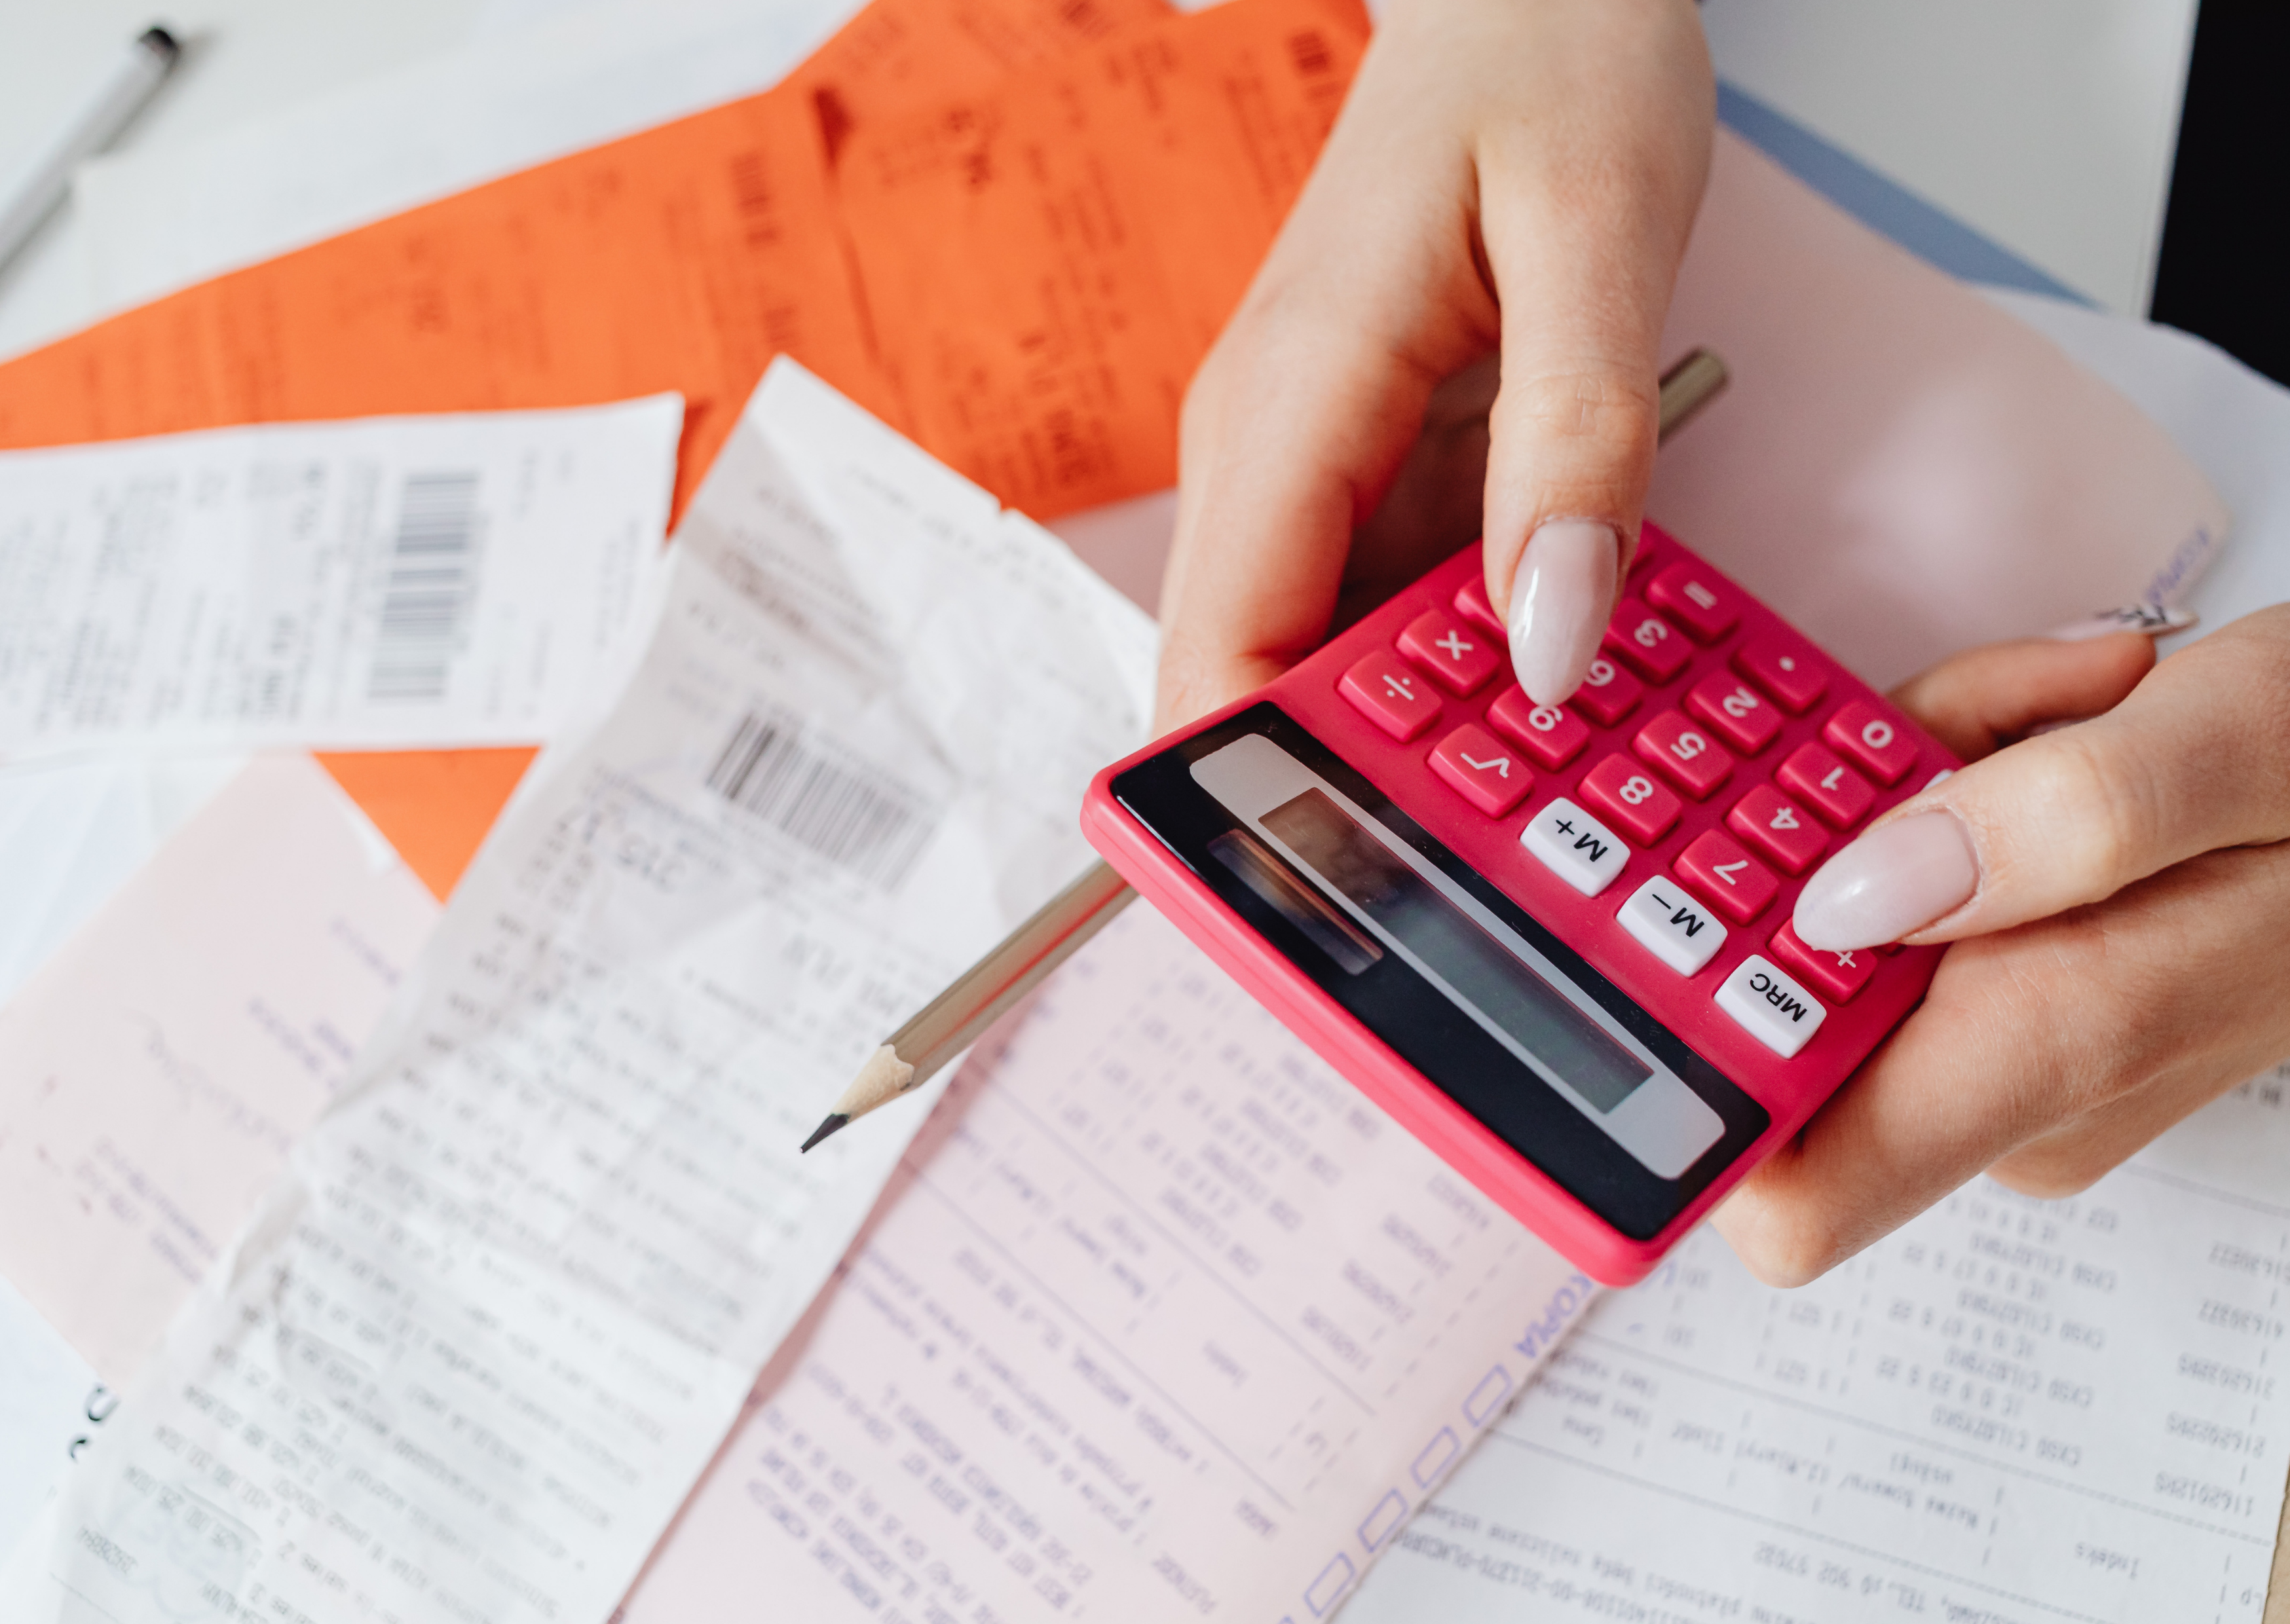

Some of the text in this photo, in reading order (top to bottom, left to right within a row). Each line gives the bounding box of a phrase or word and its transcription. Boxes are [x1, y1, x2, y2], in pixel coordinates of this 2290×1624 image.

[1634, 618, 1667, 647] 3
[1723, 687, 1759, 717] 2
[1670, 732, 1706, 760] 5
[1862, 720, 1894, 748] 0
[1619, 776, 1653, 805] 8
[1820, 766, 1843, 791] 1
[1770, 806, 1800, 829] 4
[1555, 819, 1609, 862] M+
[1712, 860, 1748, 885] 7
[1750, 972, 1807, 1023] MRC
